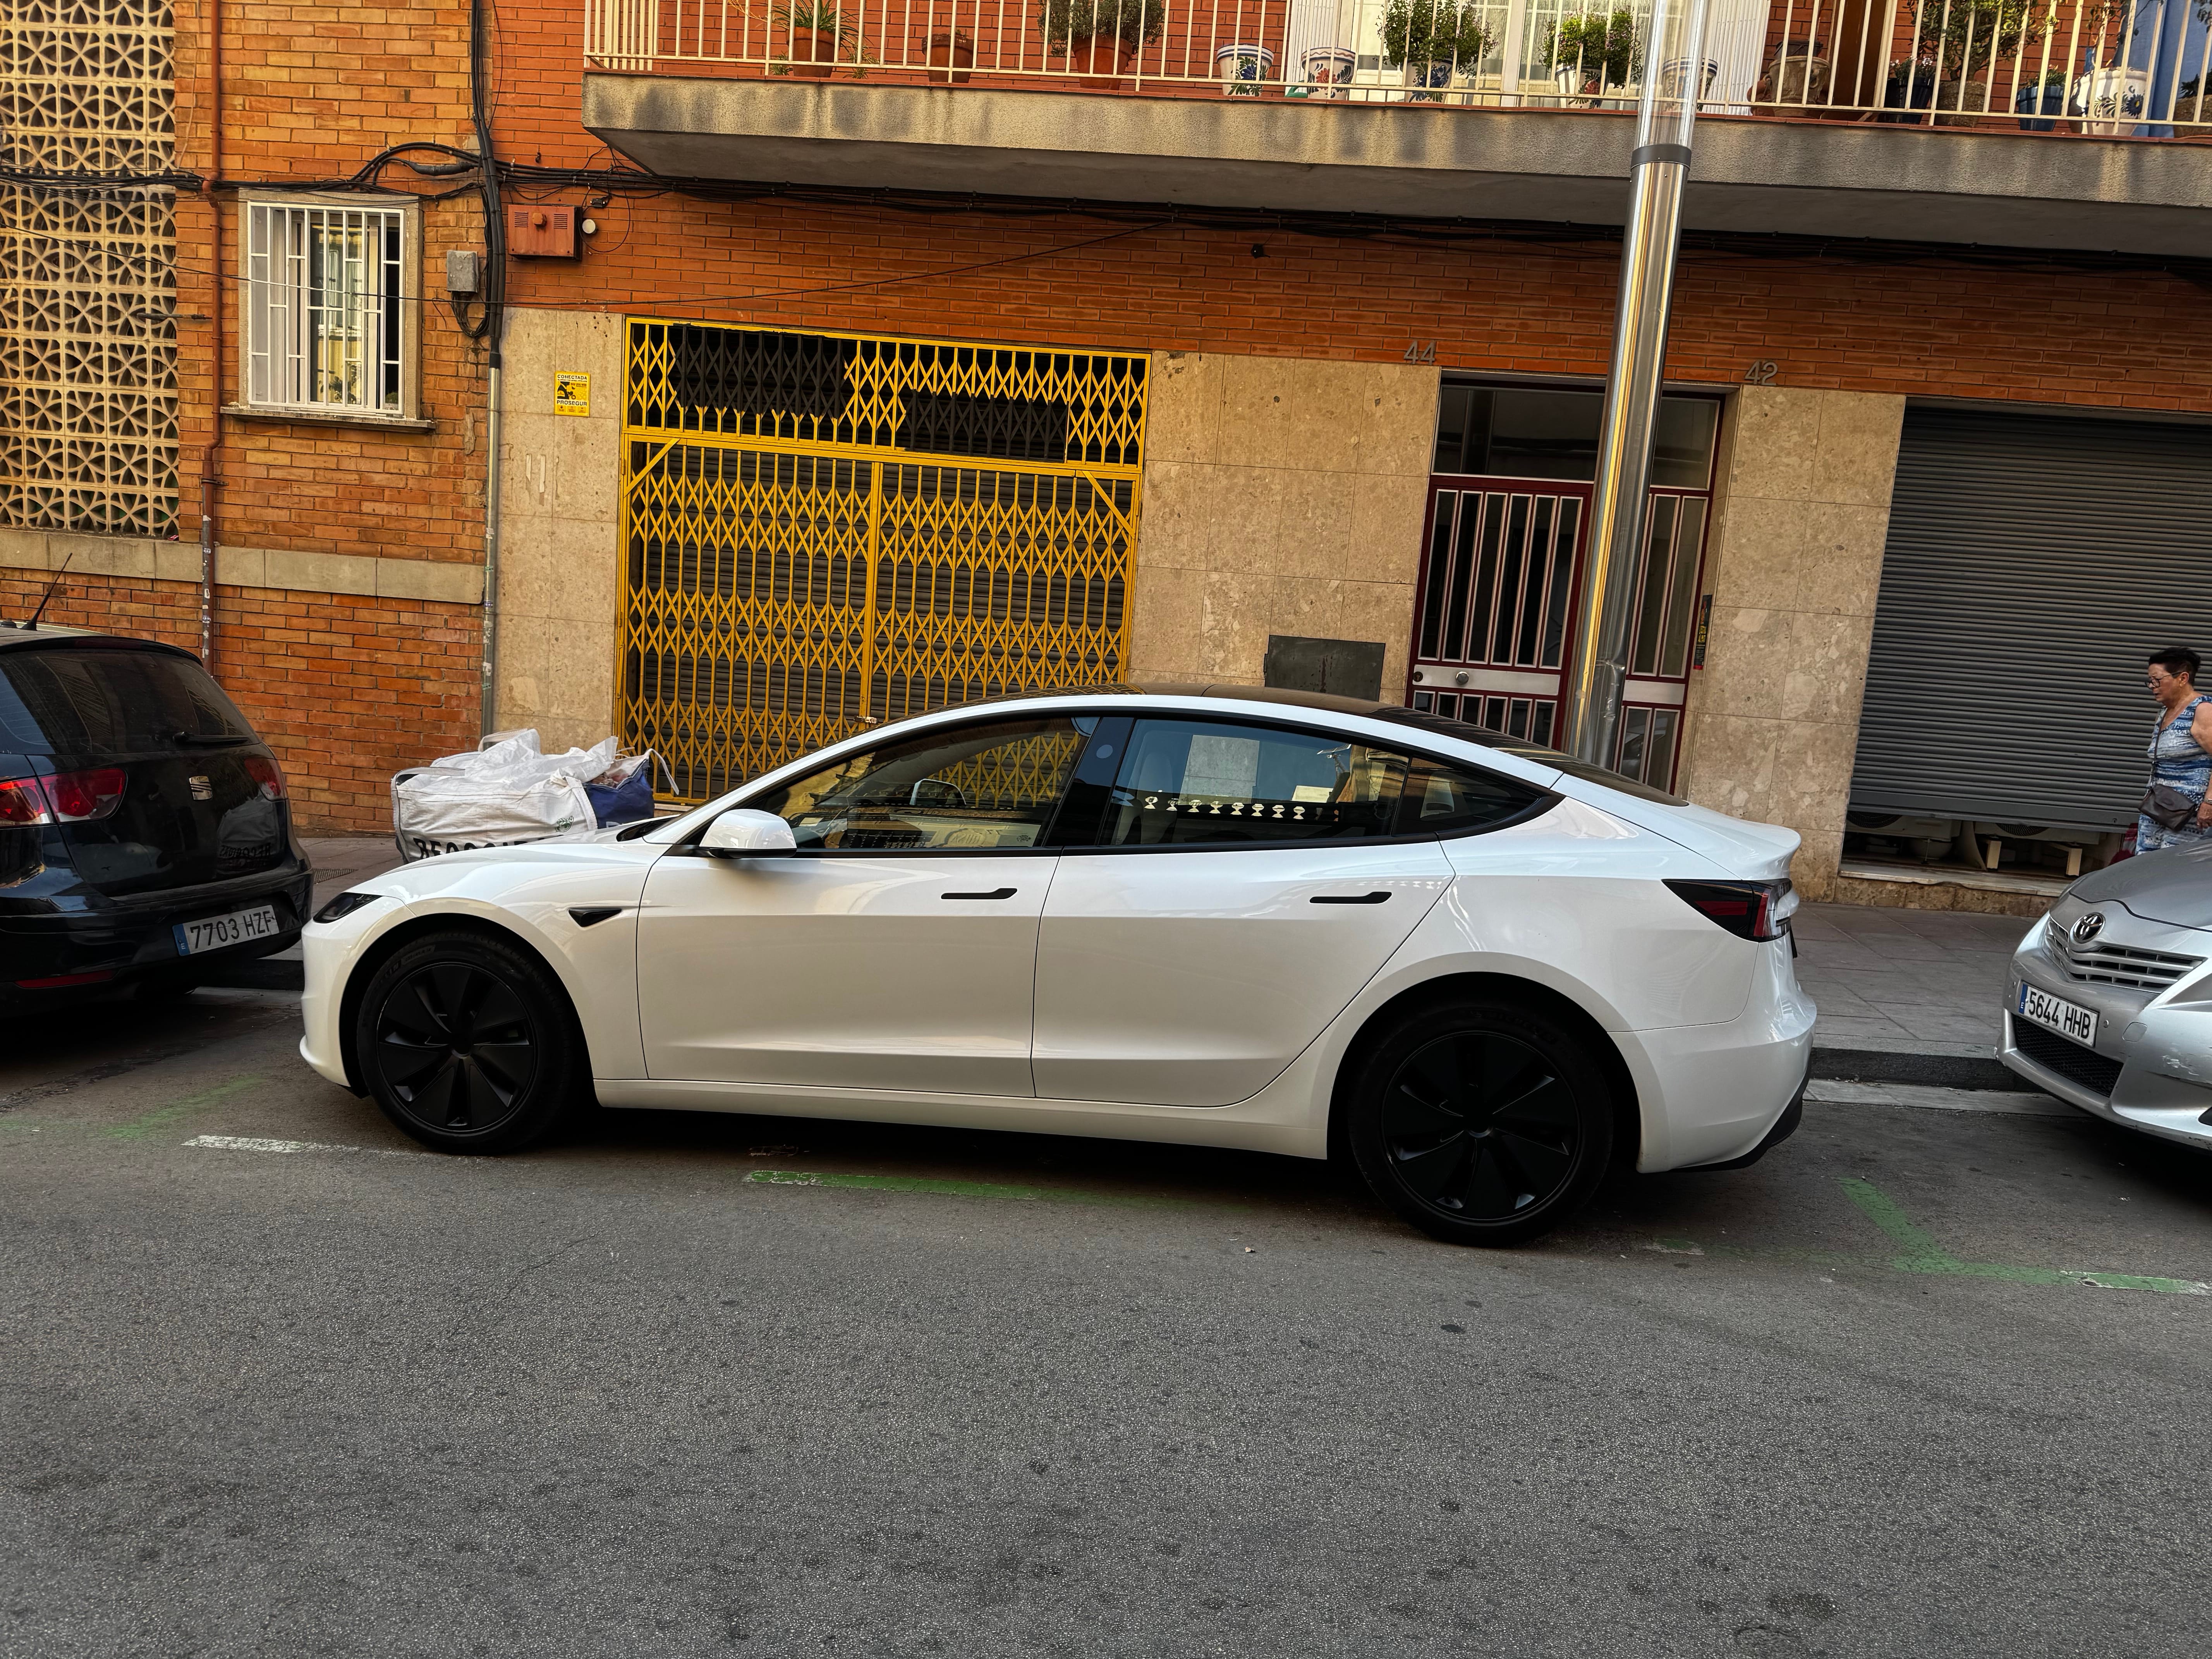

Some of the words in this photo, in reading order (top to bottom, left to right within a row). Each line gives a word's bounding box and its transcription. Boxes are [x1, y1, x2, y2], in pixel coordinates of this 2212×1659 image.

[1403, 339, 1435, 366] 44
[1744, 359, 1778, 386] 42
[190, 918, 240, 949] 7703
[243, 910, 271, 936] HZF
[2029, 991, 2060, 1026] 5644
[2063, 1006, 2091, 1039] HHB
